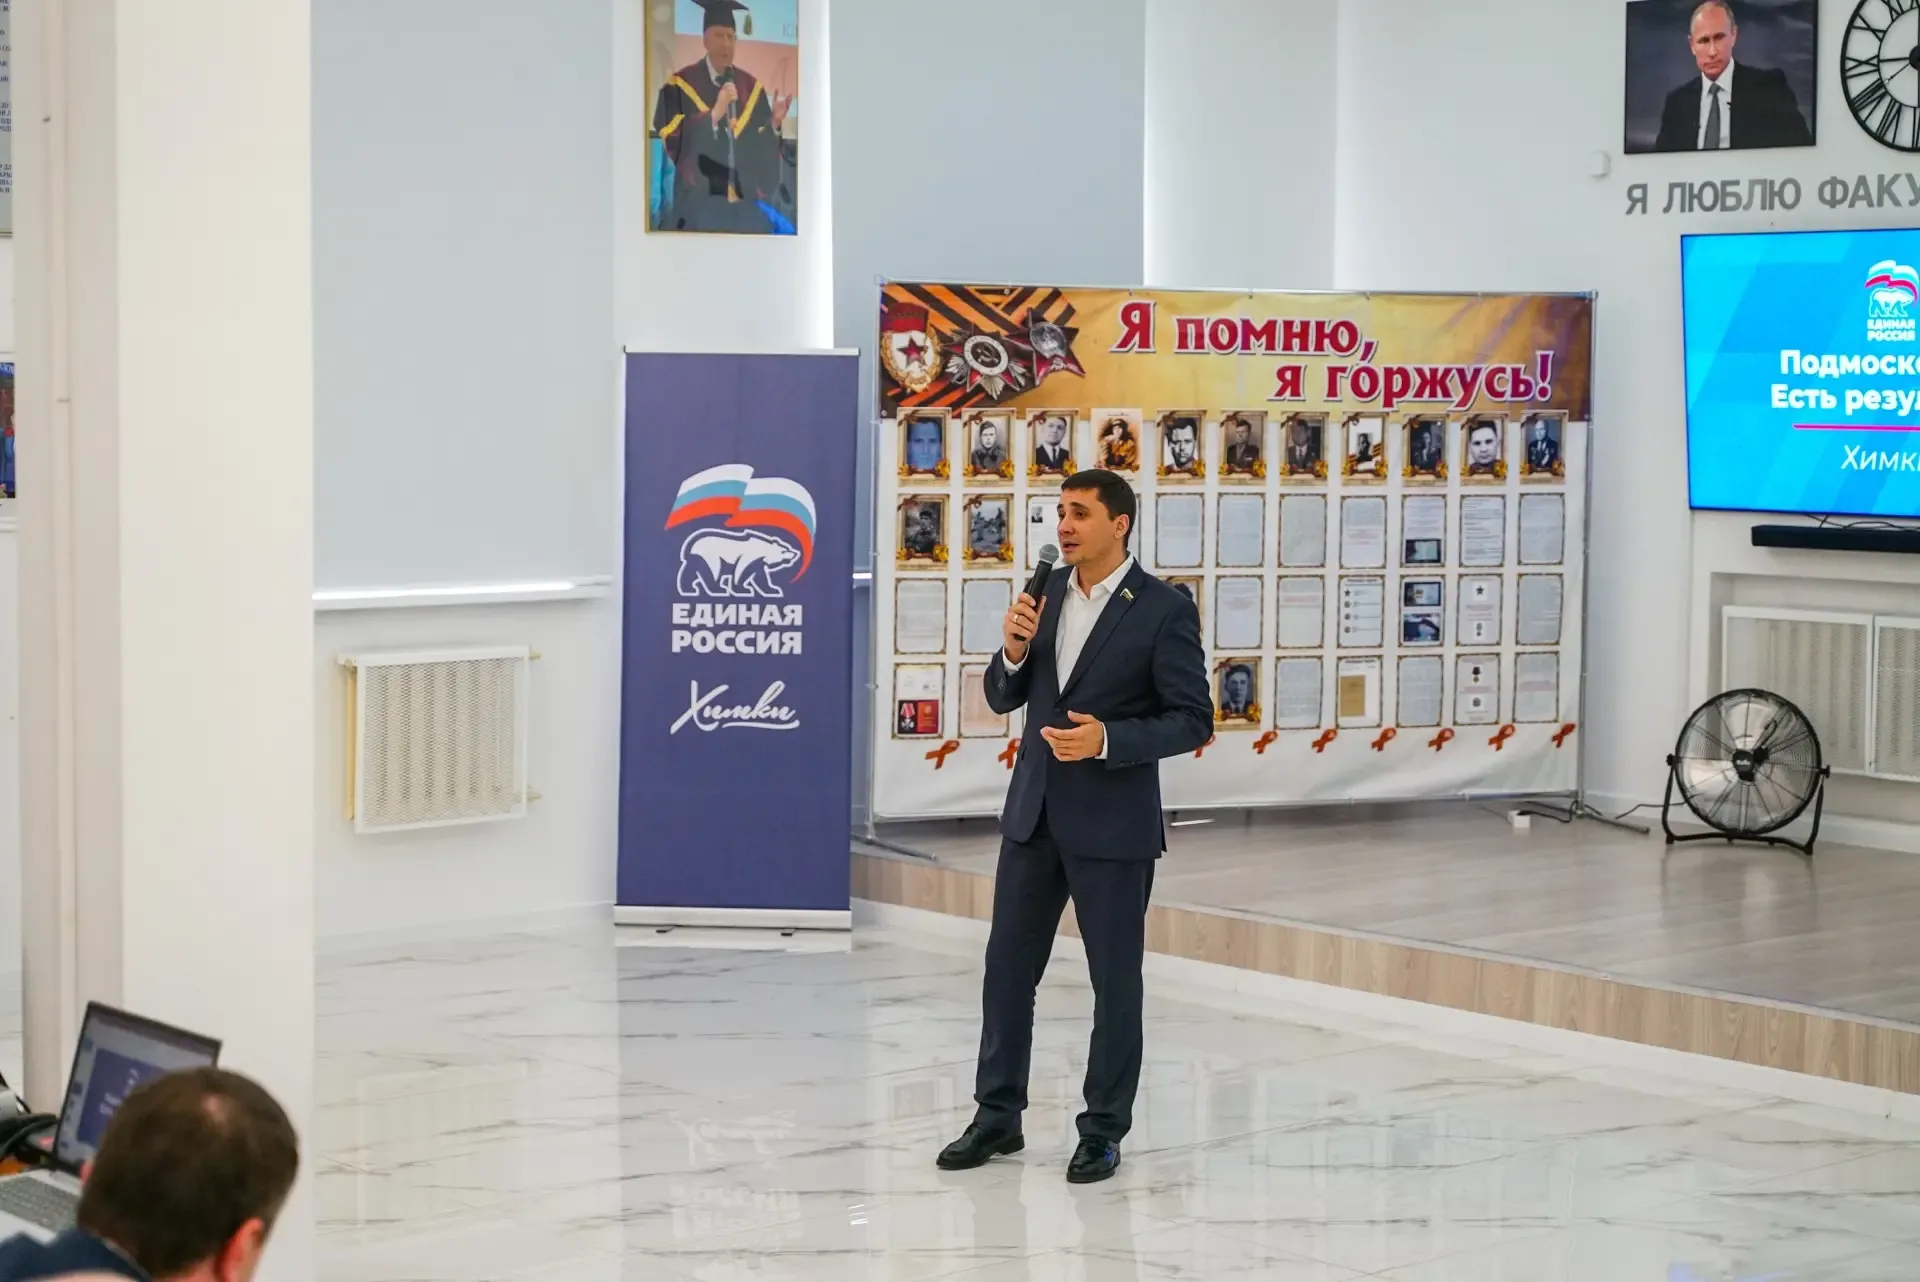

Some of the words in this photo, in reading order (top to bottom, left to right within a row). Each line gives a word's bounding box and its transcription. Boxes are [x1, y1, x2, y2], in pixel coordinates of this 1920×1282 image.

[1625, 183, 1649, 215] Я
[1662, 177, 1802, 214] ЛЮБЛЮ
[1110, 300, 1156, 352] Я
[1174, 315, 1378, 365] помню,
[1867, 330, 1916, 341] РОССИЯ
[1267, 363, 1307, 401] я
[1324, 350, 1554, 411] горжусь!
[1771, 383, 1838, 409] Есть
[1840, 444, 1920, 472] Химк
[672, 603, 802, 627] ЕДИНАЯ
[671, 630, 802, 655] РОССИЯ
[670, 680, 800, 734] Химки
